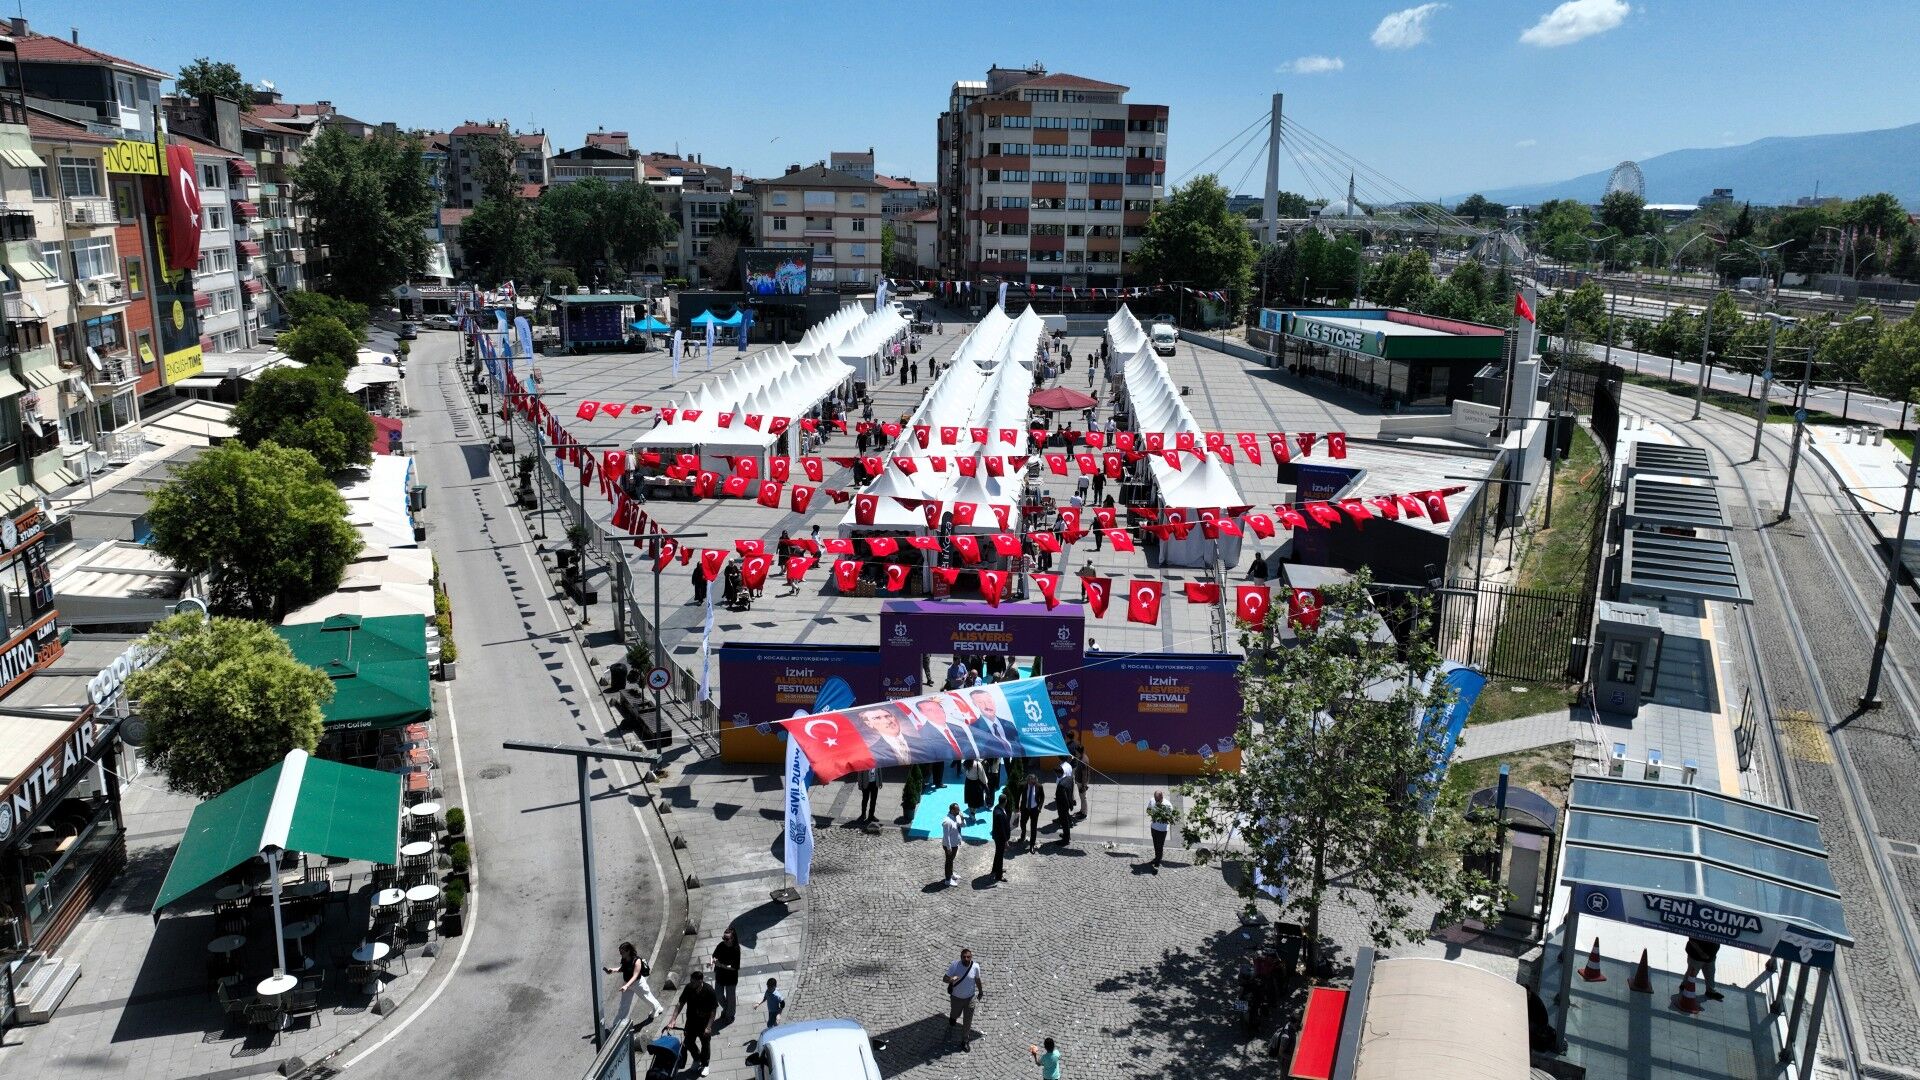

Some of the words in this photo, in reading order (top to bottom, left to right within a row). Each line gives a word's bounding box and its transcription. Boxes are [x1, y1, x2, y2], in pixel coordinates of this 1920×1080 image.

[104, 142, 157, 173] NGLISH
[1304, 322, 1320, 339] KS
[1322, 326, 1362, 349] STORE
[958, 621, 1004, 631] KOCAELİ
[0, 638, 35, 688] ATTOO
[786, 667, 814, 677] İZMİT
[777, 685, 820, 693] FESTİVAL
[1150, 676, 1178, 686] İZMİT
[62, 720, 95, 778] AIR
[1645, 894, 1693, 916] YENİ
[1700, 909, 1759, 931] CUMA
[1663, 911, 1737, 937] İSTASYONU
